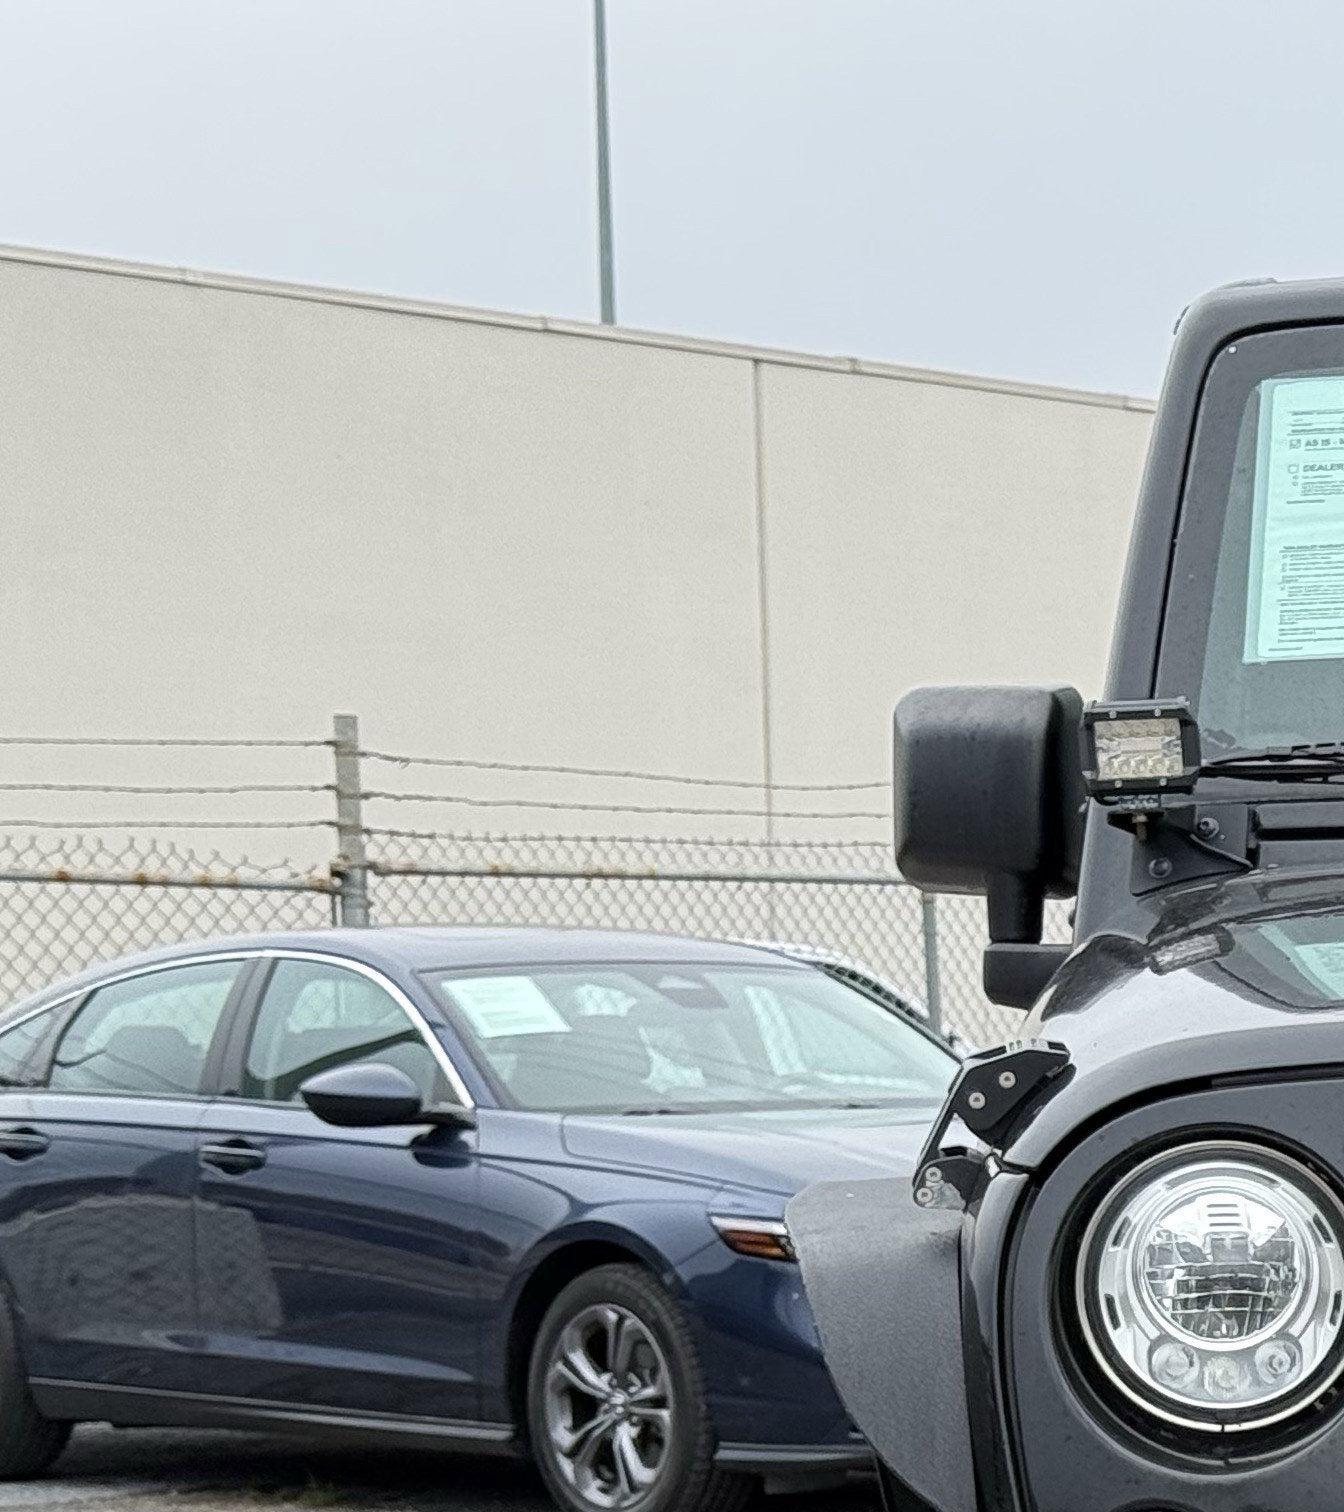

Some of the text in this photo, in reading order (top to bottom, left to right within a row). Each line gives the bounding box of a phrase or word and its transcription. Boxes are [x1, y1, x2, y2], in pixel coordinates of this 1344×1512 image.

[1305, 439, 1319, 447] AS
[1321, 438, 1331, 447] IS
[1303, 462, 1344, 472] DEALER
